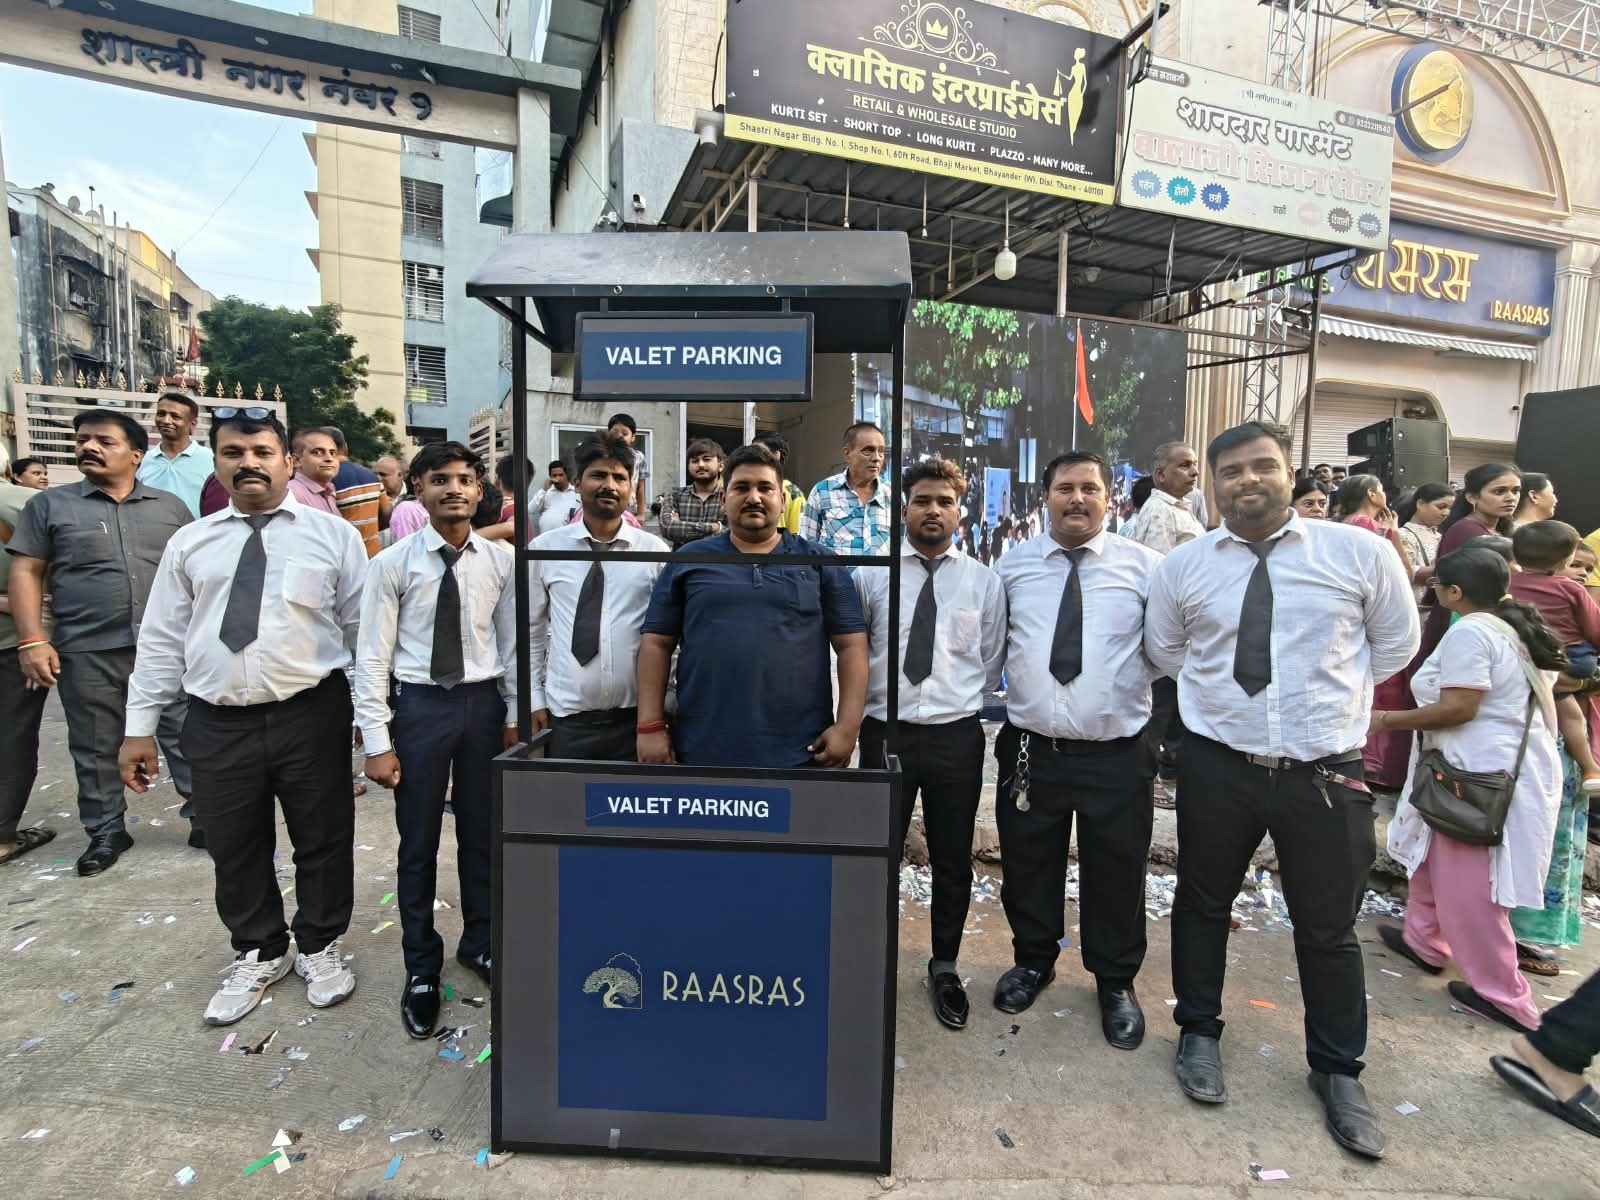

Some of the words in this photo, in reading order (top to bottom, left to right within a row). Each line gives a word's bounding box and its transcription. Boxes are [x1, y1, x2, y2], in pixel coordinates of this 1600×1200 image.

[222, 57, 306, 100] नगर
[319, 67, 399, 116] नंबर
[807, 44, 926, 94] क्लासिक
[771, 103, 806, 120] KURTI
[807, 111, 828, 124] SET
[843, 117, 880, 134] SHORT
[881, 124, 902, 138] TOP
[916, 132, 944, 147] LONG
[945, 138, 976, 153] KURTI
[990, 146, 1025, 162] PLAZZO
[1033, 155, 1059, 169] MANY
[853, 94, 894, 114] RETAIL
[897, 103, 905, 116] &
[907, 106, 977, 131] WHOLESALE
[979, 121, 1017, 139] STUDIO
[1176, 96, 1270, 145] शानदार
[1275, 120, 1353, 160] गारमेंट
[739, 121, 771, 135] Shastri
[773, 127, 799, 141] Nagar
[848, 141, 869, 154] Shop
[983, 166, 1022, 182] Bhayander
[1056, 180, 1078, 193] Thane
[1490, 300, 1551, 327] RAASRAS
[605, 346, 676, 366] VALET
[682, 346, 782, 366] PARKING
[607, 797, 672, 814] VALET
[678, 798, 769, 818] PARKING
[663, 970, 806, 1007] RAASRAS
